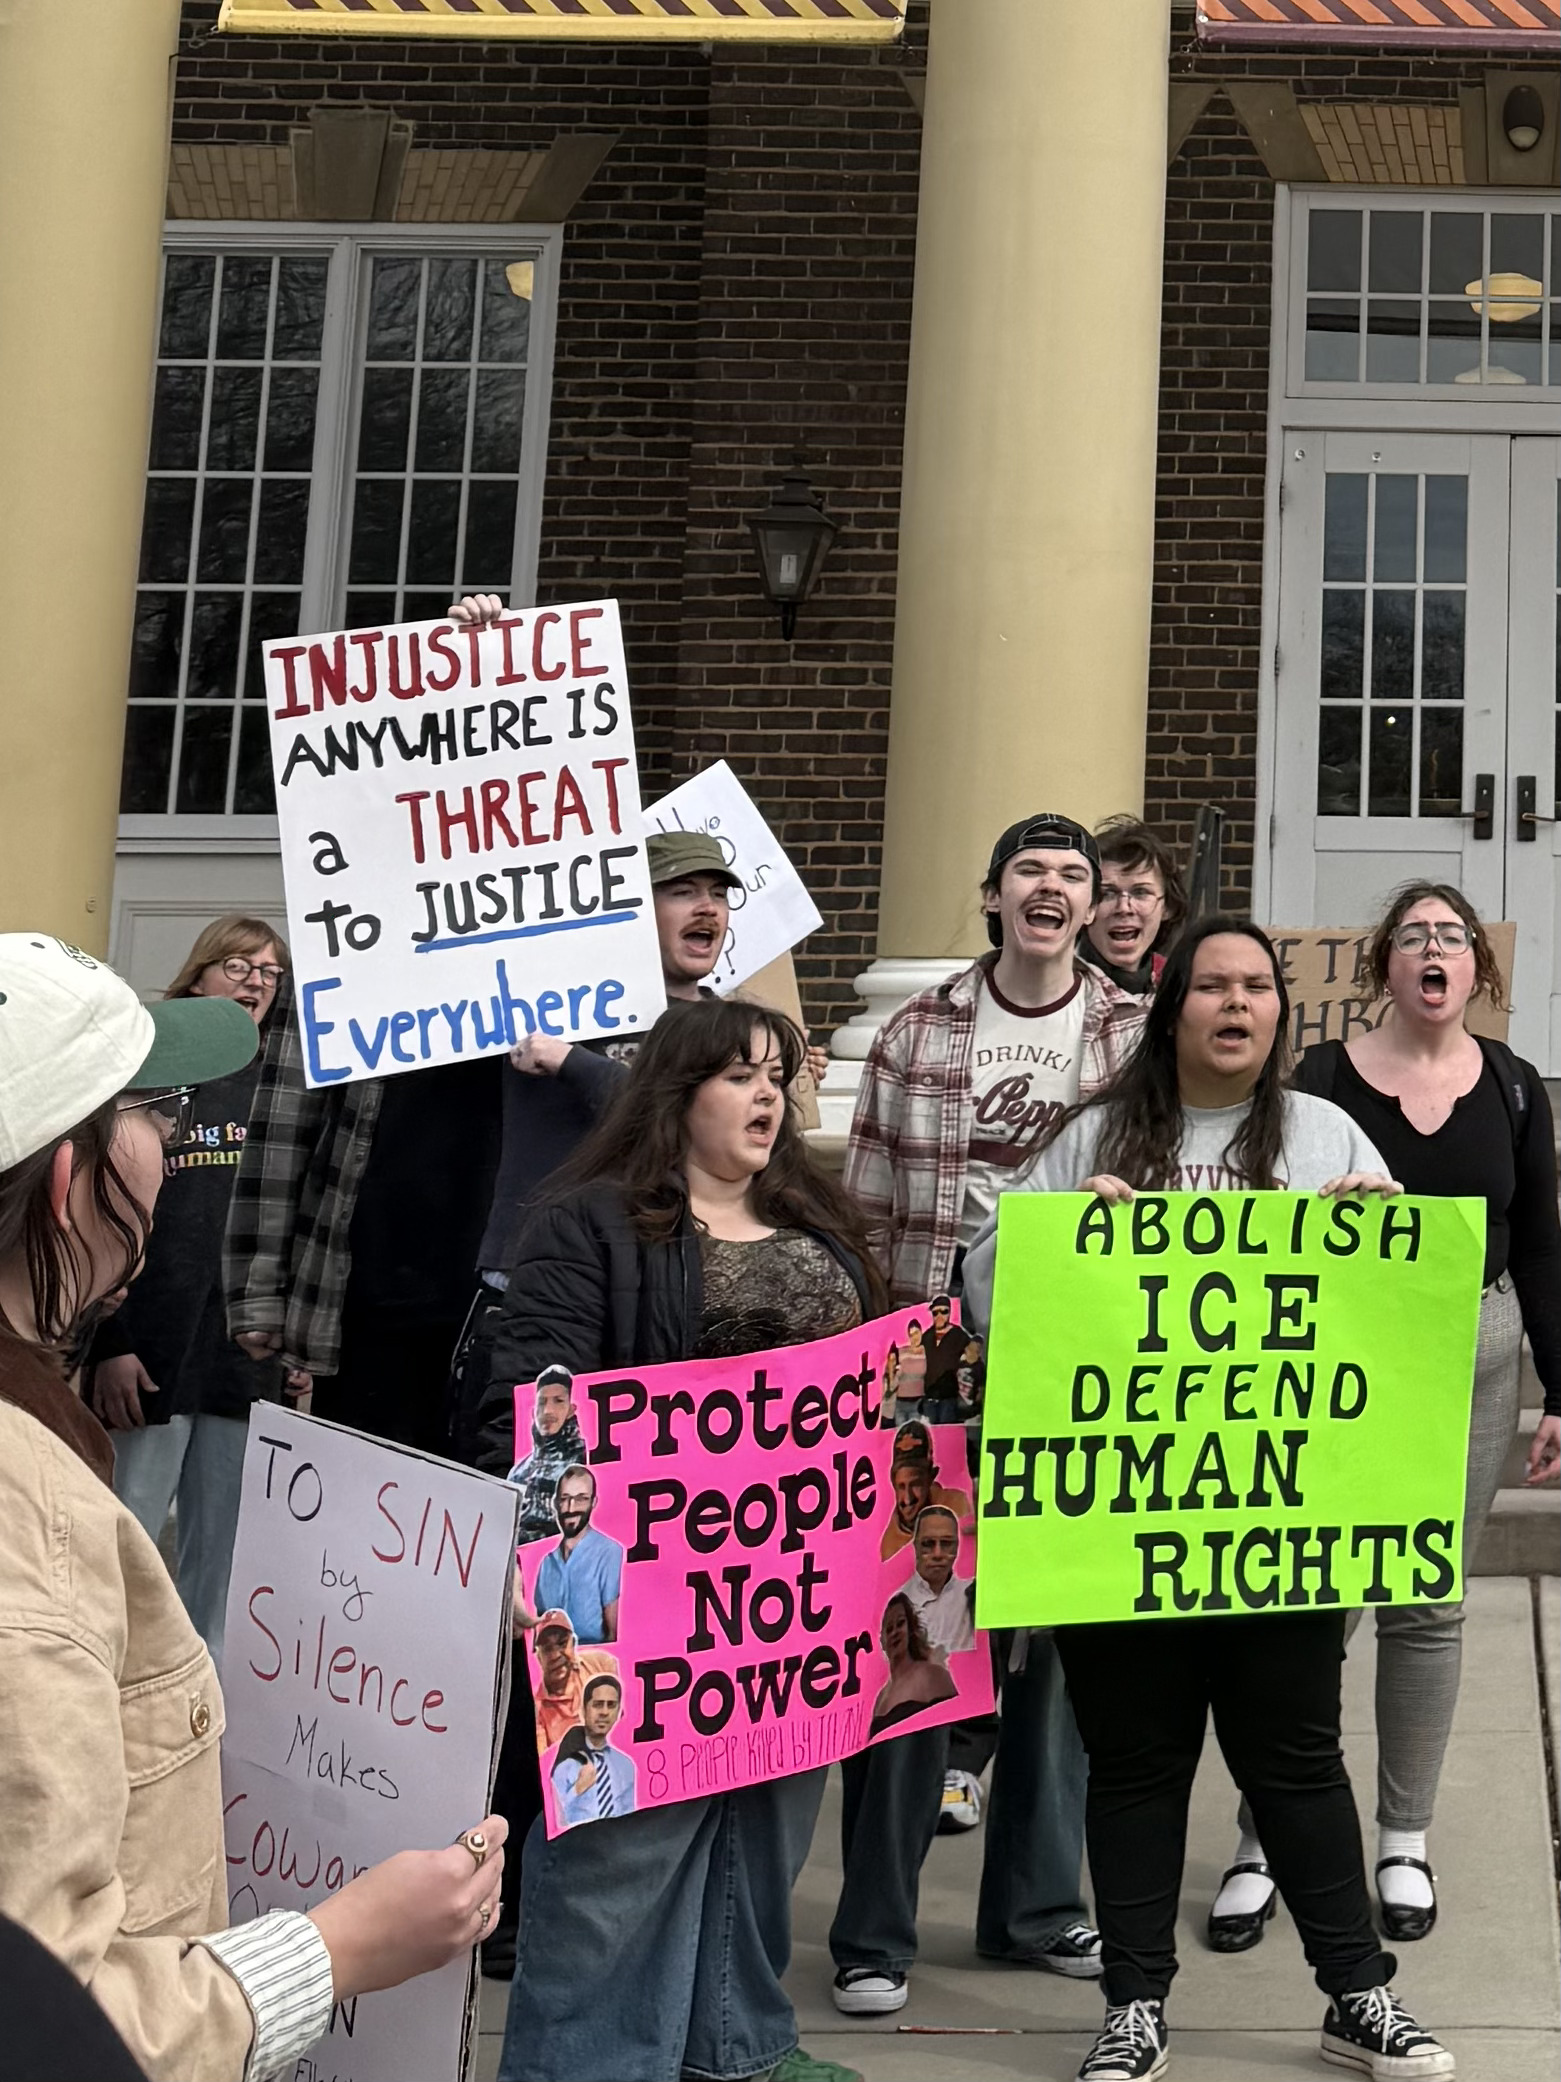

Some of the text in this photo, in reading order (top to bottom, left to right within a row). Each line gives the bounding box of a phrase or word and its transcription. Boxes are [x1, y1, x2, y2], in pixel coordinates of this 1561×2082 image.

[270, 608, 609, 720] INJUSTICE
[281, 682, 617, 786] ANYWHERE IS
[308, 831, 350, 876] a
[395, 757, 630, 864] THREAT
[305, 900, 381, 957] to
[411, 846, 642, 942] JUSTICE
[301, 959, 638, 1083] Everywhere.
[976, 1044, 1072, 1072] DRINK!
[1076, 1196, 1422, 1262] ABOLISH
[1137, 1271, 1320, 1353] ICE
[587, 1350, 881, 1465] Protect
[1071, 1361, 1368, 1423] DEFEND
[626, 1451, 877, 1564] People
[983, 1430, 1309, 1518] HUMAN
[321, 1549, 373, 1622] by
[371, 1482, 484, 1588] SIN
[1134, 1519, 1455, 1613] RIGHTS
[686, 1552, 833, 1654] Not
[249, 1586, 447, 1732] Silence
[633, 1629, 873, 1744] Power
[285, 1714, 399, 1799] Makes
[646, 1748, 669, 1800] 8
